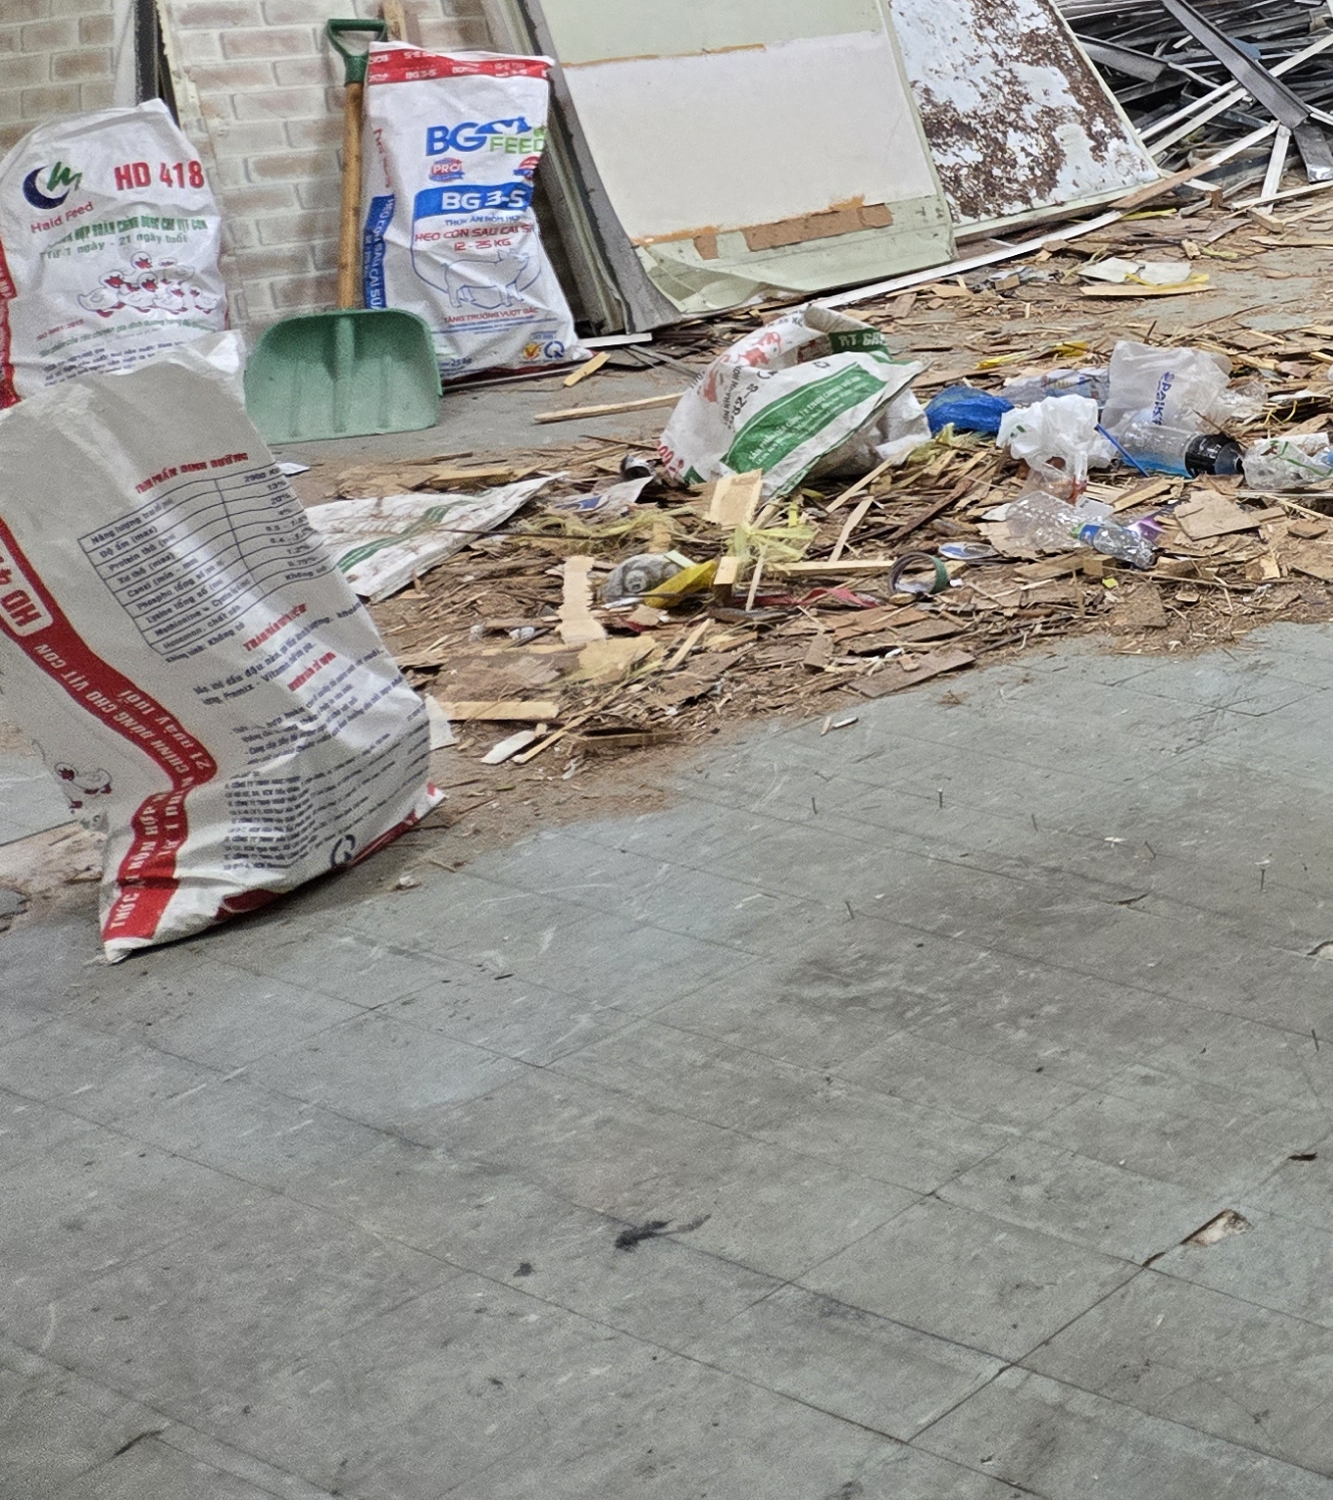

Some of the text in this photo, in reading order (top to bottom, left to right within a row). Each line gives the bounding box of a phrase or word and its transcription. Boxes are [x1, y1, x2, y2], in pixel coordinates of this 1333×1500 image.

[426, 122, 487, 156] BG
[114, 160, 205, 191] HD 418
[65, 201, 94, 221] Feed
[442, 192, 481, 210] BG
[415, 233, 441, 242] HEO
[444, 229, 469, 239] CON
[34, 643, 66, 669] CON
[85, 691, 118, 713] CHO
